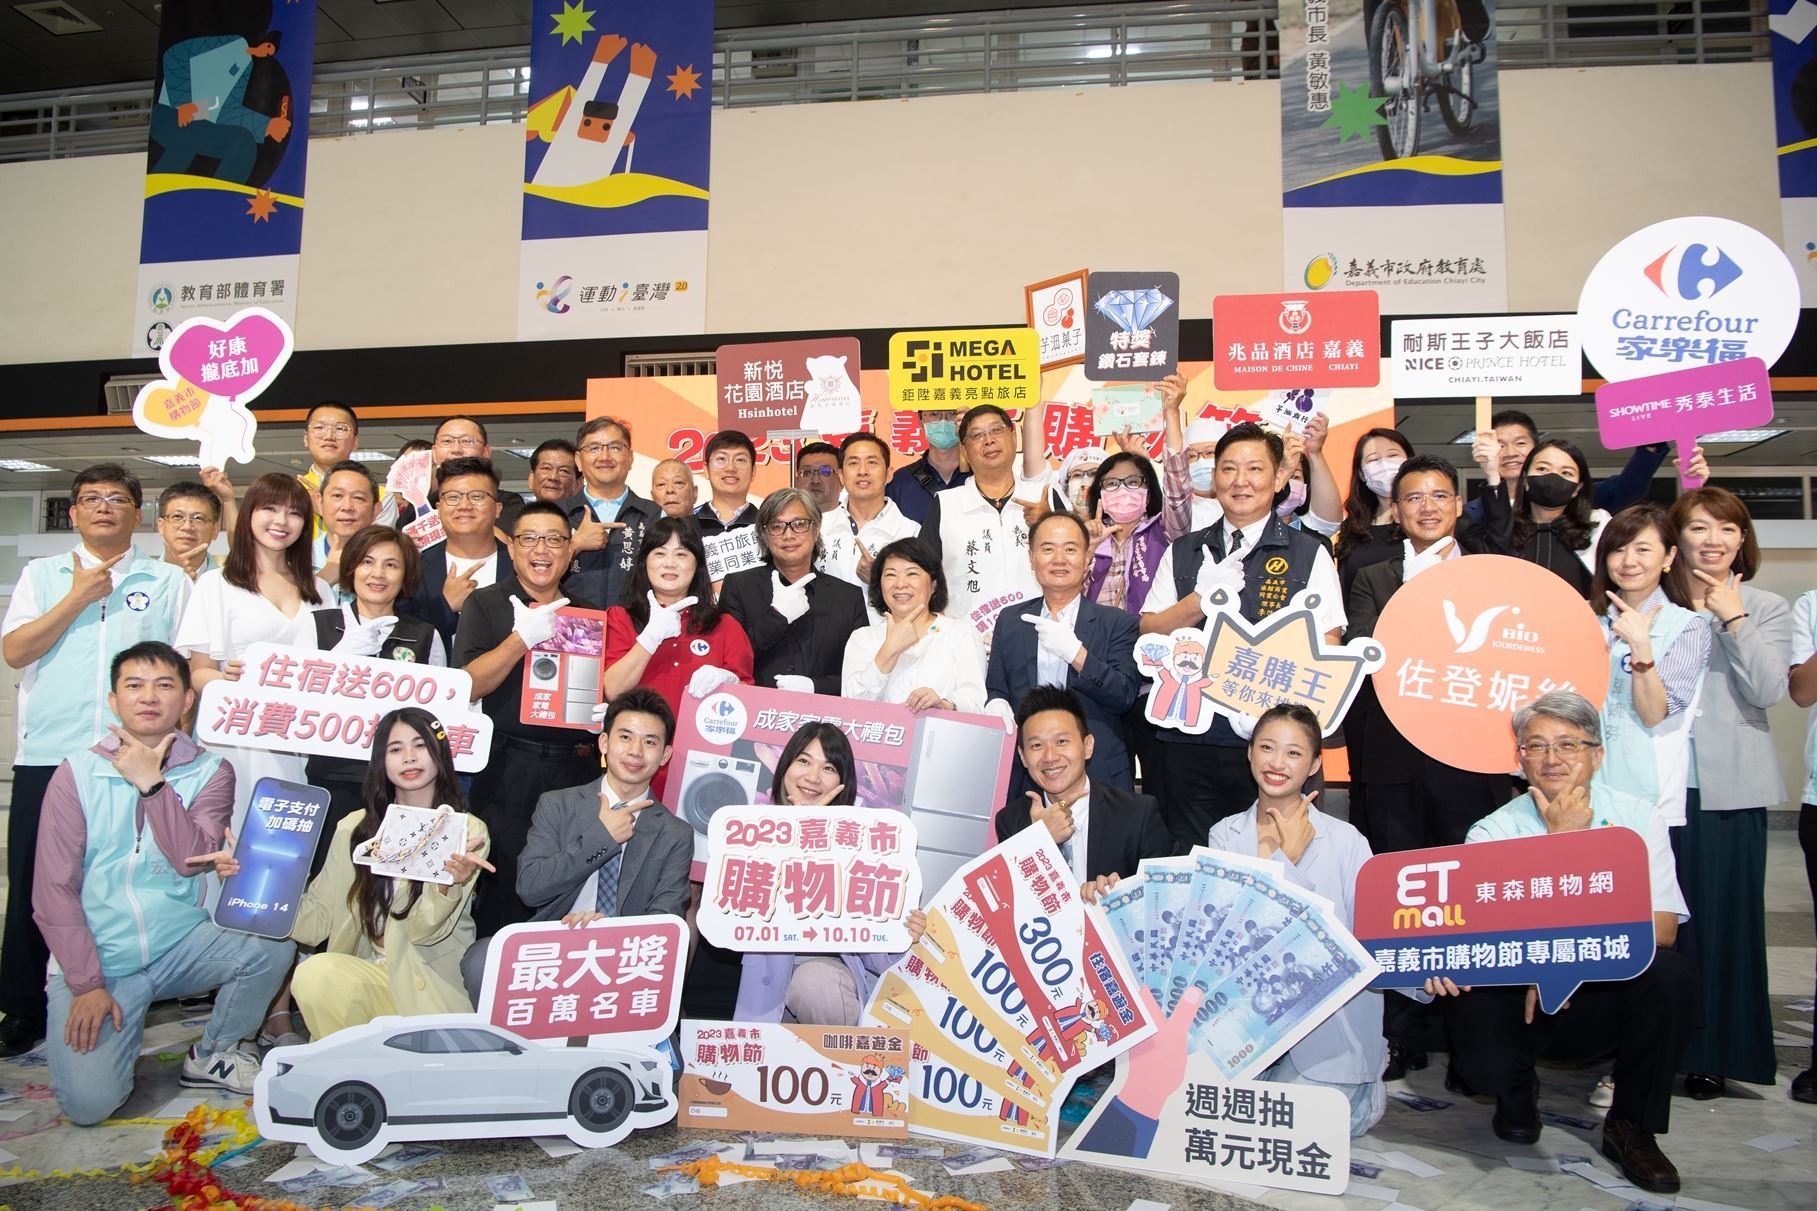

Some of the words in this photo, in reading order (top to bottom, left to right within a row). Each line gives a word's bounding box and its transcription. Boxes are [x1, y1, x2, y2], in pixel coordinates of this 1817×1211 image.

[1308, 52, 1331, 111] 黃敏惠
[1344, 256, 1487, 279] 嘉義市政府教育處
[180, 279, 285, 301] 教育部體育署
[1345, 278, 1391, 287] Department
[1403, 277, 1441, 285] Education
[1443, 277, 1468, 286] Chiayi
[1470, 276, 1486, 284] City
[1612, 308, 1759, 334] Carrefour
[208, 336, 247, 360] 好康
[950, 339, 1016, 357] MEGA
[1228, 341, 1315, 362] 兆品酒店
[1322, 339, 1365, 359] 嘉義
[1403, 329, 1568, 353] 耐斯王子大飯店
[1615, 335, 1748, 364] 家樂福
[200, 356, 259, 383] 攏底加
[950, 363, 1026, 381] HOTEL
[1233, 365, 1268, 373] MAISON
[1286, 364, 1313, 372] CHINE
[1328, 363, 1359, 371] CHIAYI
[1405, 358, 1444, 371] NICE
[1465, 356, 1514, 369] PRINCE
[1519, 355, 1566, 368] HOTEL
[163, 386, 195, 410] 嘉義市
[723, 380, 805, 404] 花園酒店
[902, 386, 1026, 402] 鉅陞嘉義亮點旅店
[1674, 382, 1757, 413] 秀泰生活
[169, 398, 201, 422] 購物節
[738, 406, 798, 419] Hsinhotel
[1609, 398, 1671, 418] SHOWTIME
[1631, 413, 1652, 421] LIVE
[1224, 646, 1332, 704] 嘉購王
[704, 716, 739, 728] Carrefour
[258, 796, 321, 817] 電子支付
[265, 815, 314, 833] 加碼抽
[717, 858, 903, 917] 購物節
[1396, 860, 1461, 906] ET
[1475, 871, 1614, 904] 東森購物網
[227, 898, 268, 910] iPhone
[273, 902, 289, 912] 14
[1393, 904, 1466, 930] mall
[735, 926, 779, 942] 07.01
[783, 933, 798, 942] SAT.
[823, 926, 870, 942] 10.10
[872, 934, 888, 942] TUE.
[507, 934, 668, 992] 最大獎
[1374, 934, 1630, 974] 嘉義市購物節專屬商城
[506, 988, 661, 1027] 百萬名車
[696, 1043, 764, 1065] 購物節
[823, 1033, 903, 1052] 咖啡嘉遊金
[1226, 1043, 1255, 1069] 1000
[1184, 1083, 1294, 1129] 週週抽
[1184, 1127, 1333, 1180] 萬元現金
